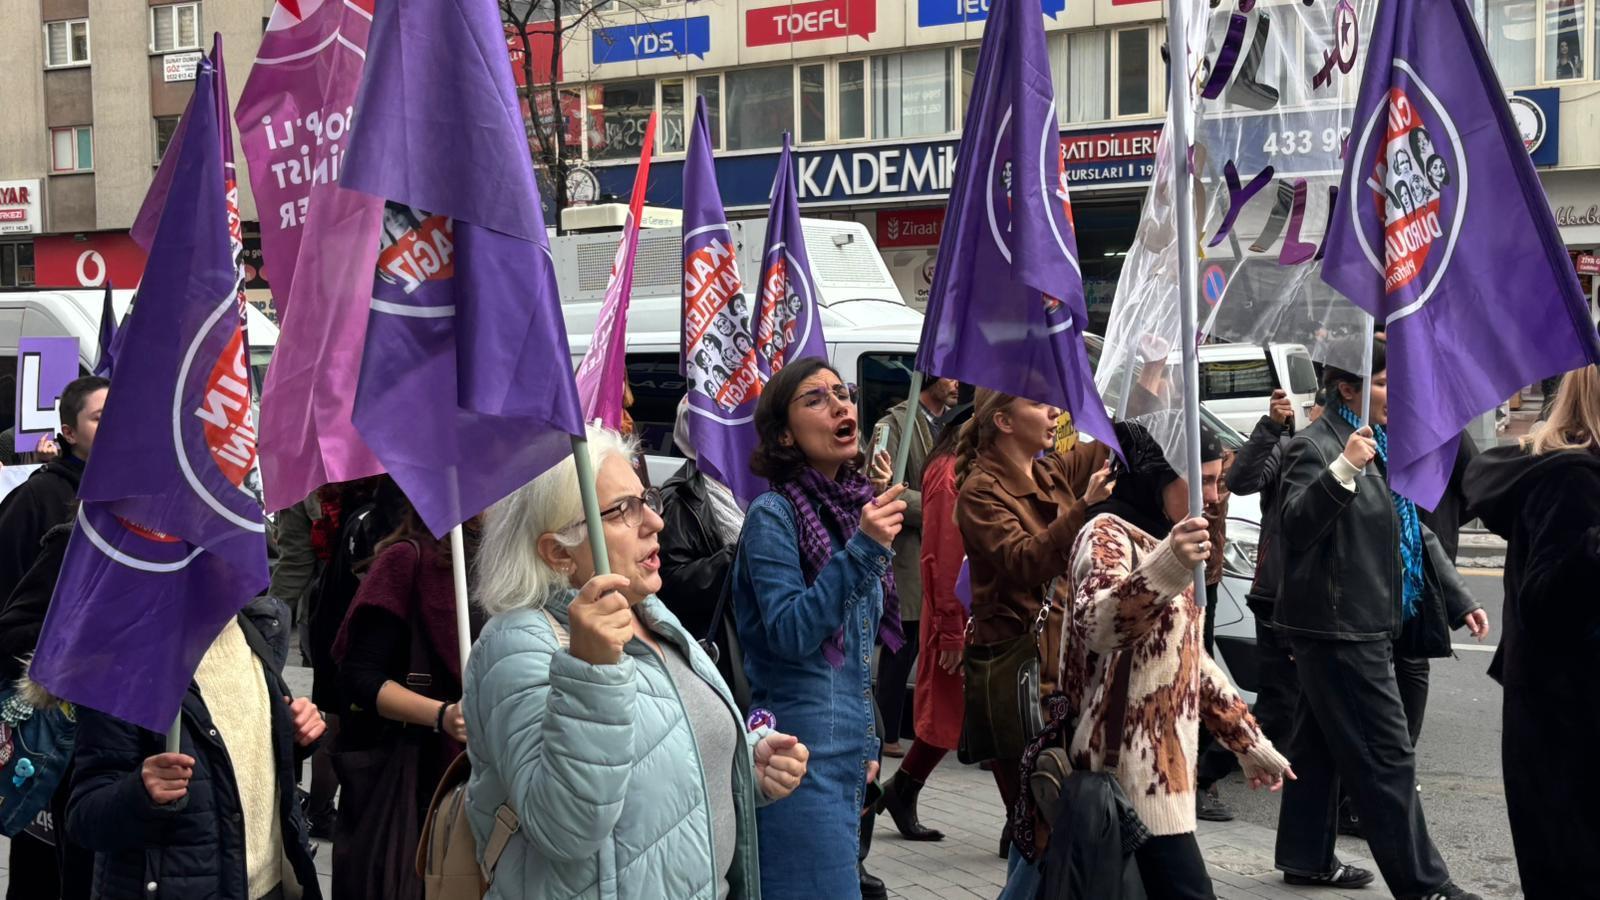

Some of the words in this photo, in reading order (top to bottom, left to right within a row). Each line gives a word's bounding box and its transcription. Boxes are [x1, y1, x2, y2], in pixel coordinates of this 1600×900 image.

[773, 8, 848, 36] TOEFL
[629, 31, 674, 55] YDS
[1097, 130, 1158, 158] DİLLERİ
[1263, 129, 1313, 156] 433
[770, 146, 957, 199] KADEMİK
[1140, 165, 1154, 177] 19
[0, 186, 29, 205] YAR
[902, 222, 937, 236] Ziraat
